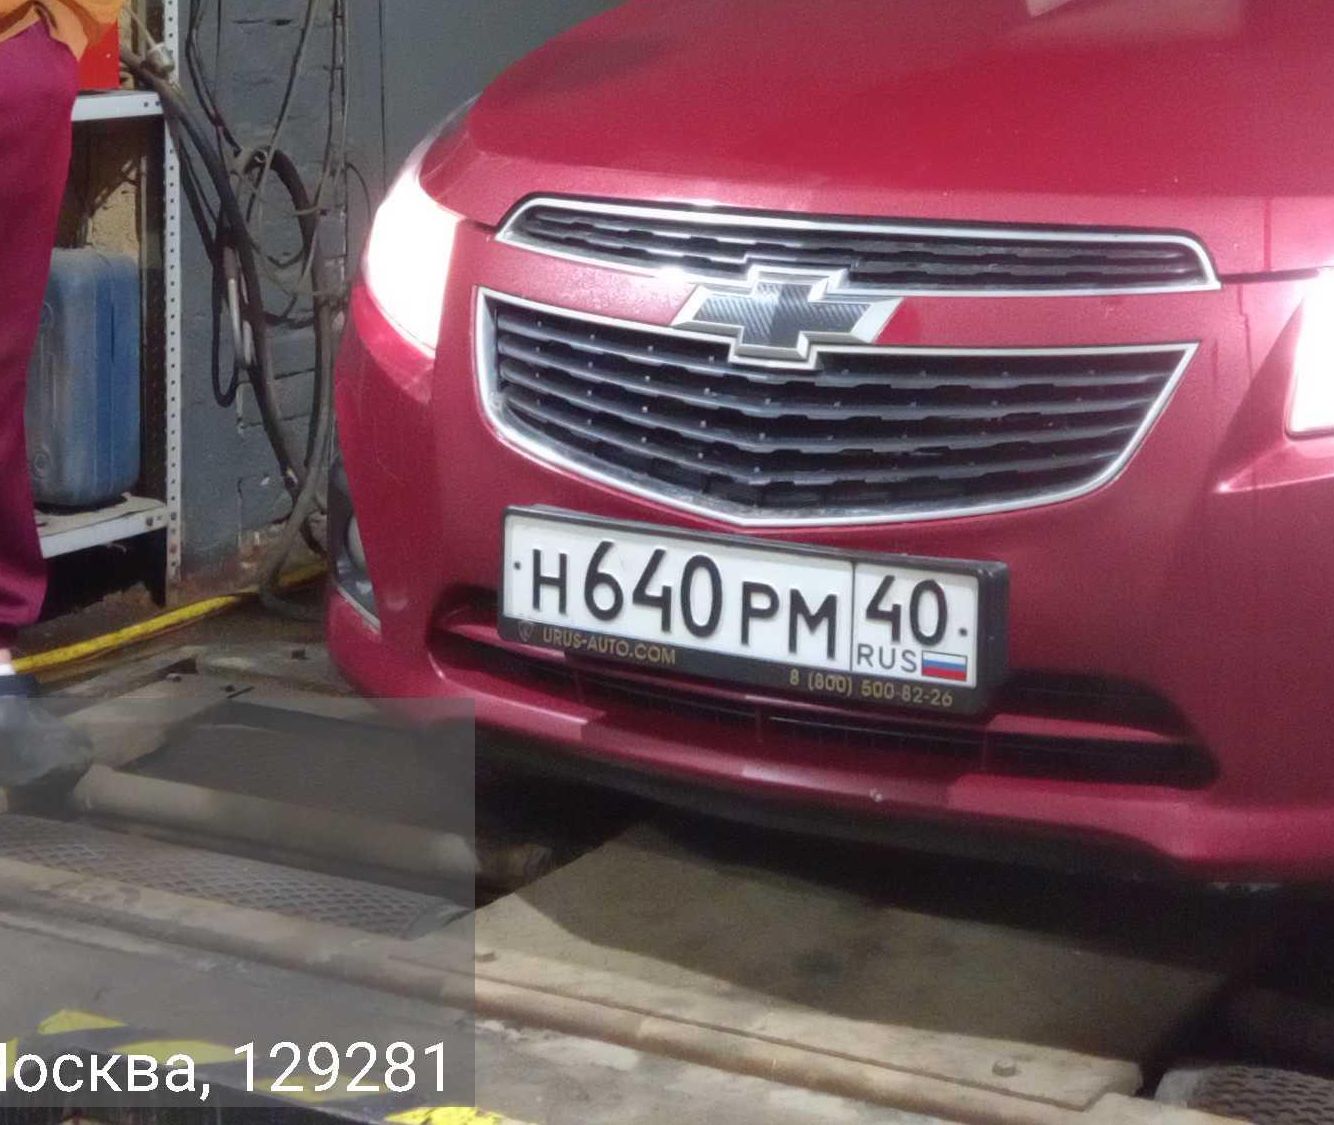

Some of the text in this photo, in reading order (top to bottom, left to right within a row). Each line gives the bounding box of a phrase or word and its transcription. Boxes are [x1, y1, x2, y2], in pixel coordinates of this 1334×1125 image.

[866, 574, 948, 646] 40
[543, 627, 676, 666] URUS-AUTO.COM
[856, 644, 917, 674] RUS
[789, 669, 954, 709] 8 (800) 500-82-26
